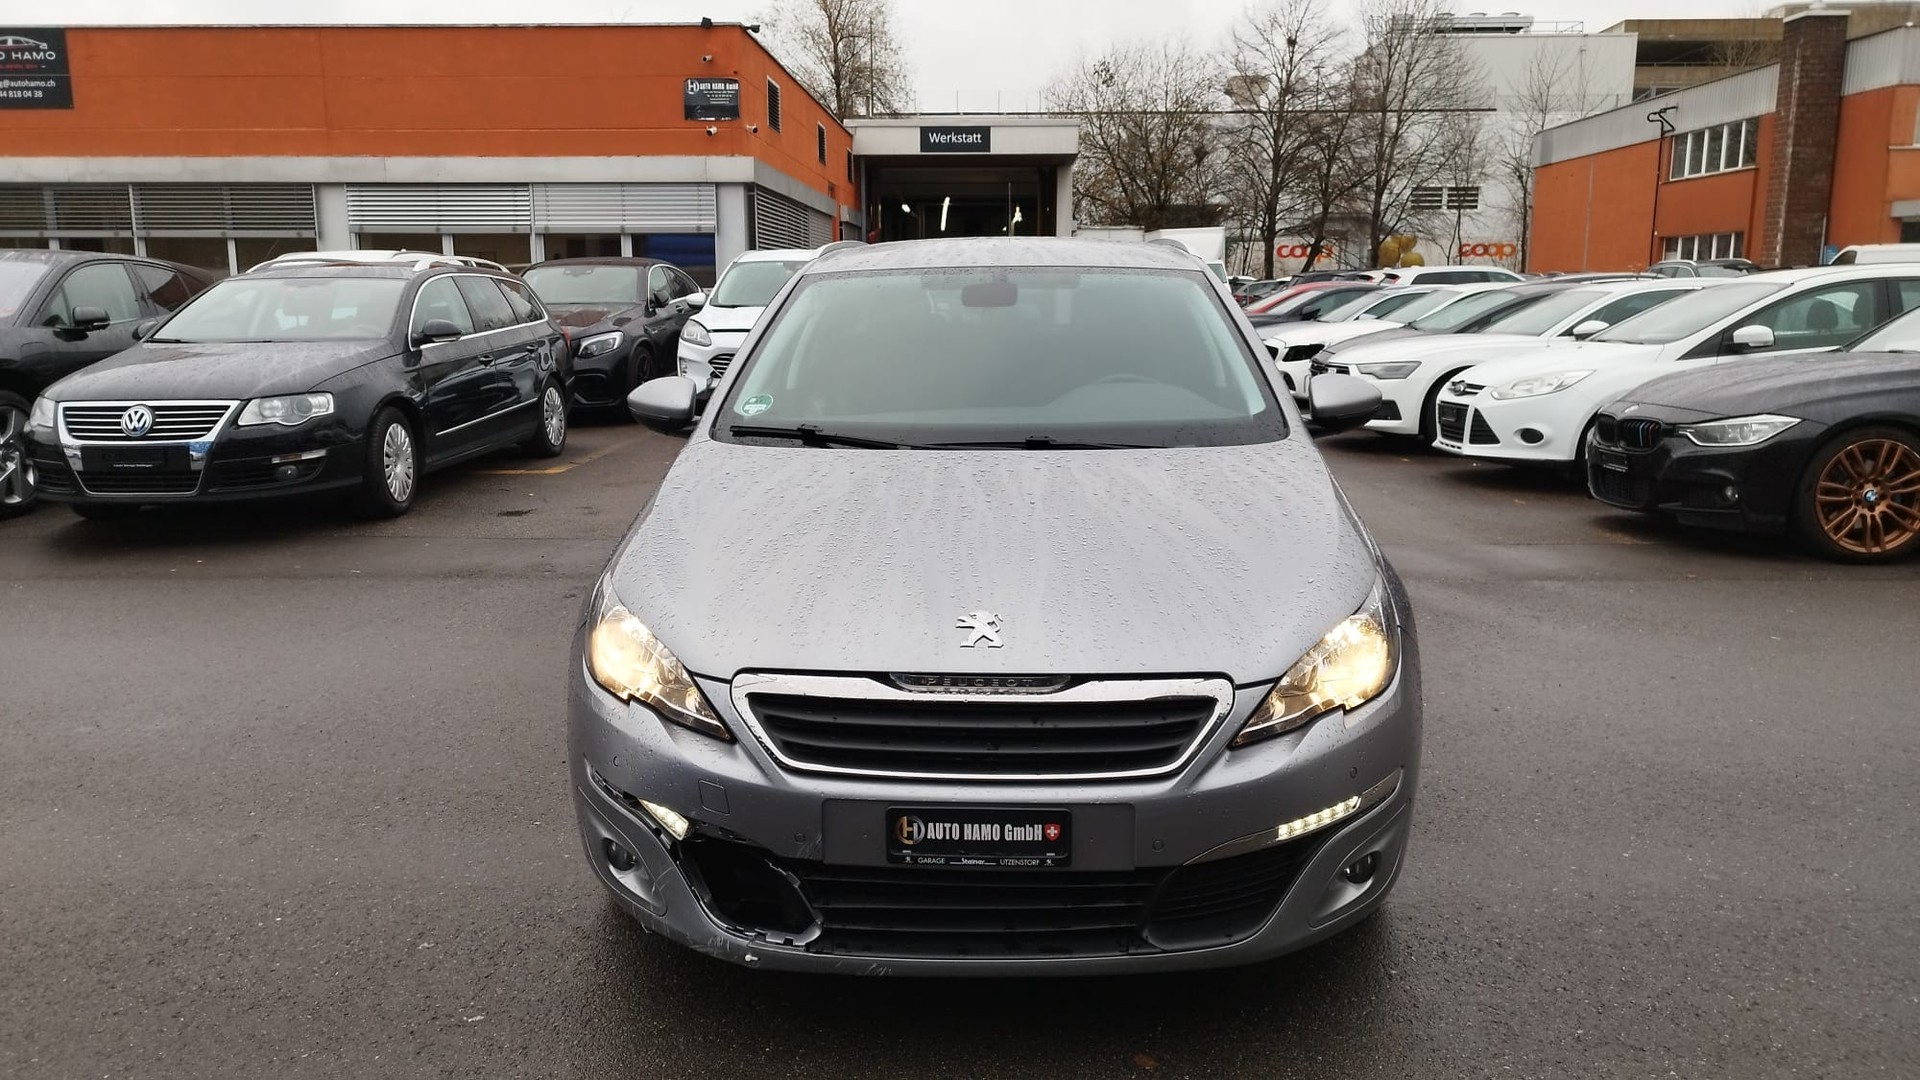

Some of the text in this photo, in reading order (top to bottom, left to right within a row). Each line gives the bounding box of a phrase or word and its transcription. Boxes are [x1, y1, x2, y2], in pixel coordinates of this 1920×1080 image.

[12, 51, 56, 60] HAMO
[929, 132, 982, 143] Werkstatt
[1458, 243, 1517, 261] coop
[927, 678, 1033, 687] PEUGEOT
[927, 822, 1043, 842] AUTO HAMO GmbH
[917, 856, 946, 865] GARAGE
[999, 858, 1040, 867] UTZENSTORF
